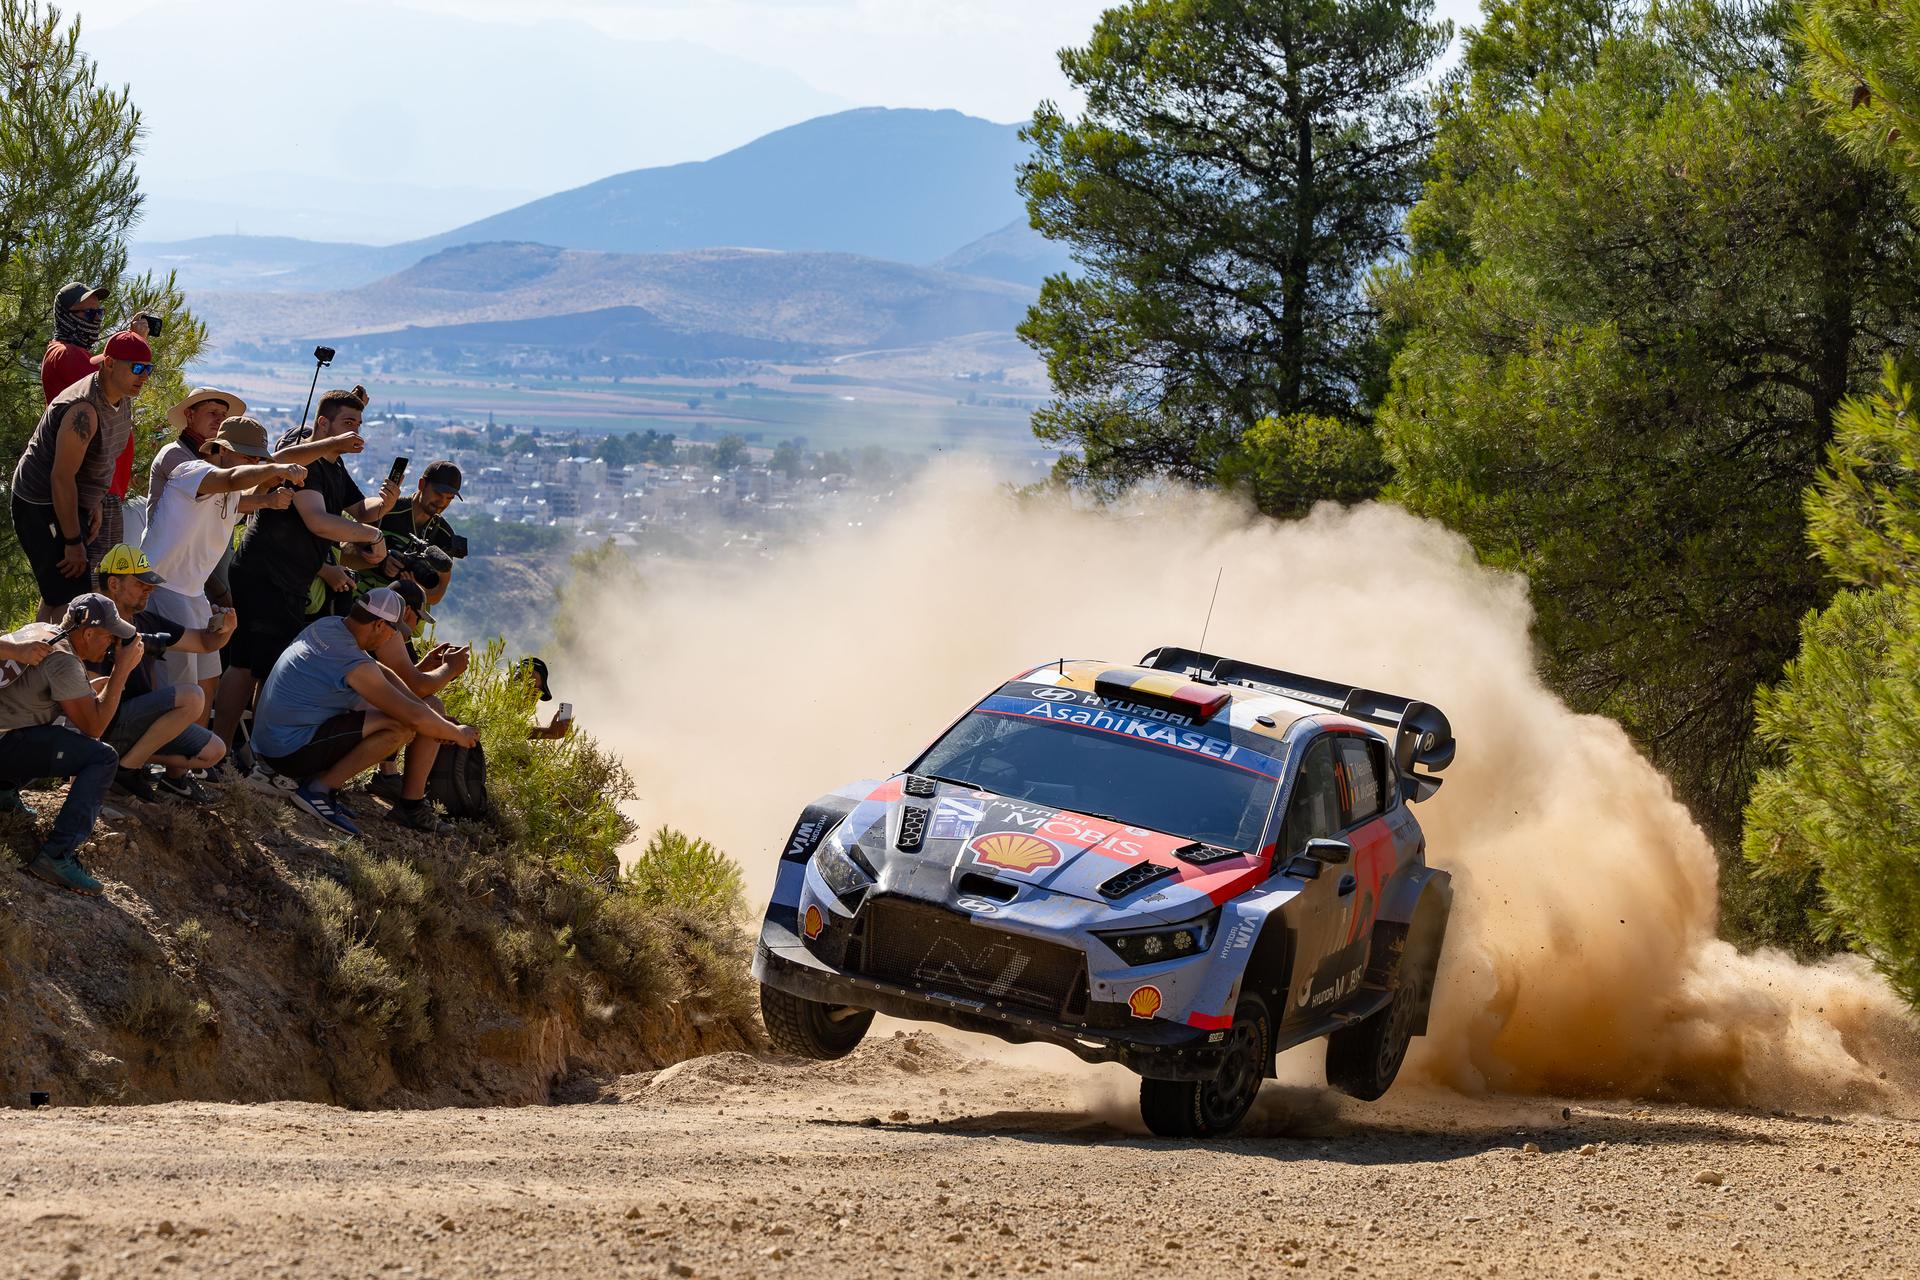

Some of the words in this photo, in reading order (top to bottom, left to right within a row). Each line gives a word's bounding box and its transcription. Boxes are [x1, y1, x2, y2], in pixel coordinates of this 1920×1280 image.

[1082, 695, 1194, 726] HYUNDAI
[992, 801, 1089, 826] HYUNDAI
[1001, 812, 1144, 856] MOBIS
